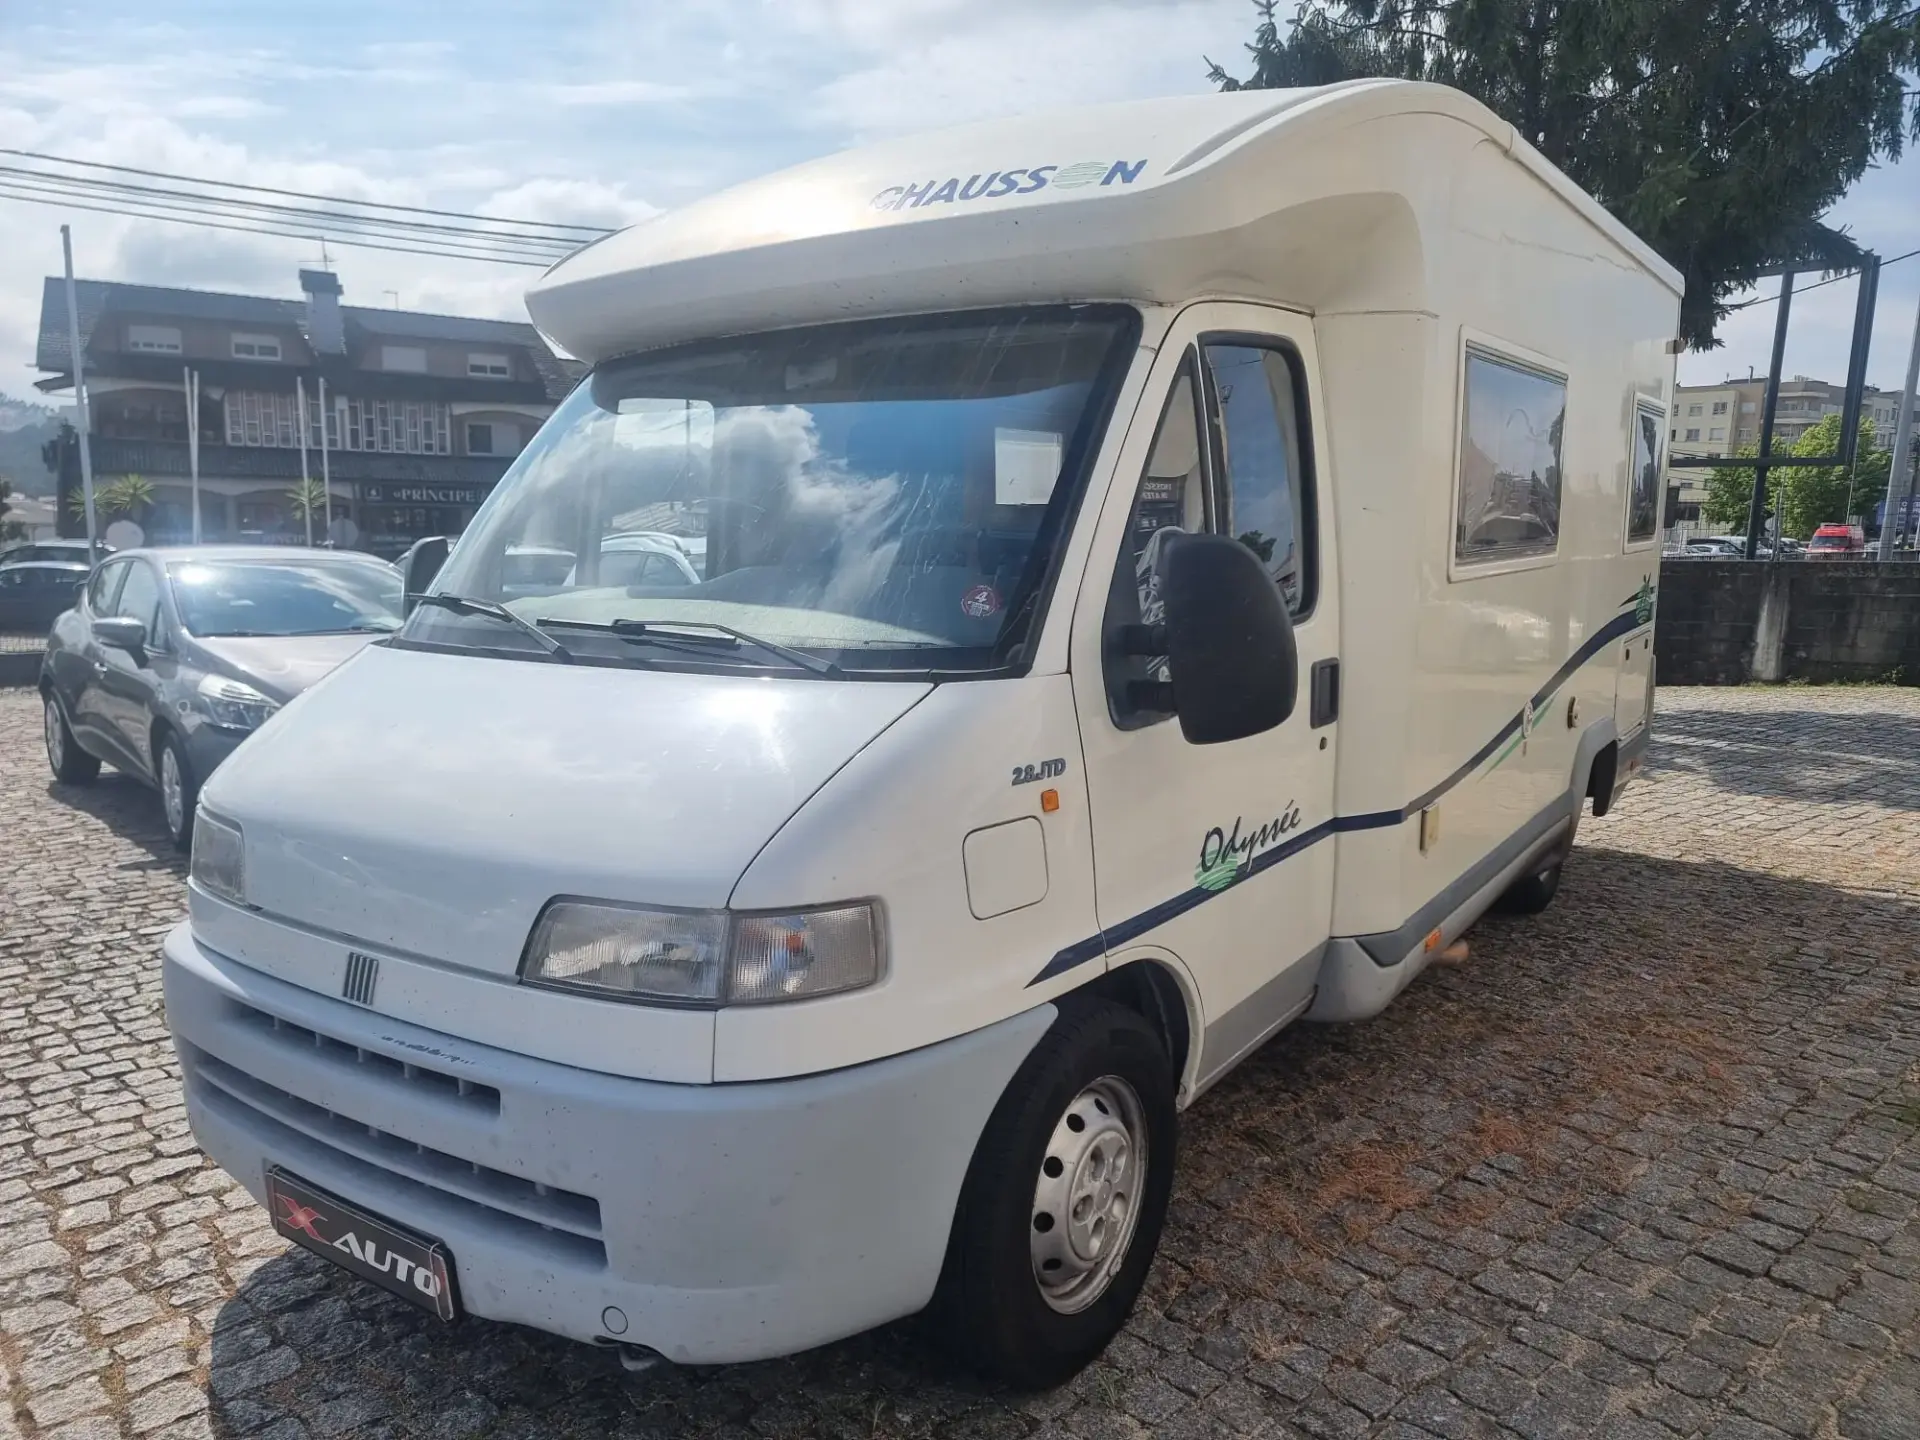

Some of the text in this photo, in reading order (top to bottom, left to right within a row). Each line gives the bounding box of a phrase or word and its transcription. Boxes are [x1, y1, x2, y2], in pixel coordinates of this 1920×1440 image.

[868, 157, 1148, 211] CHAUSSON
[1199, 799, 1302, 873] Odyssée
[331, 1231, 442, 1298] AUTO
